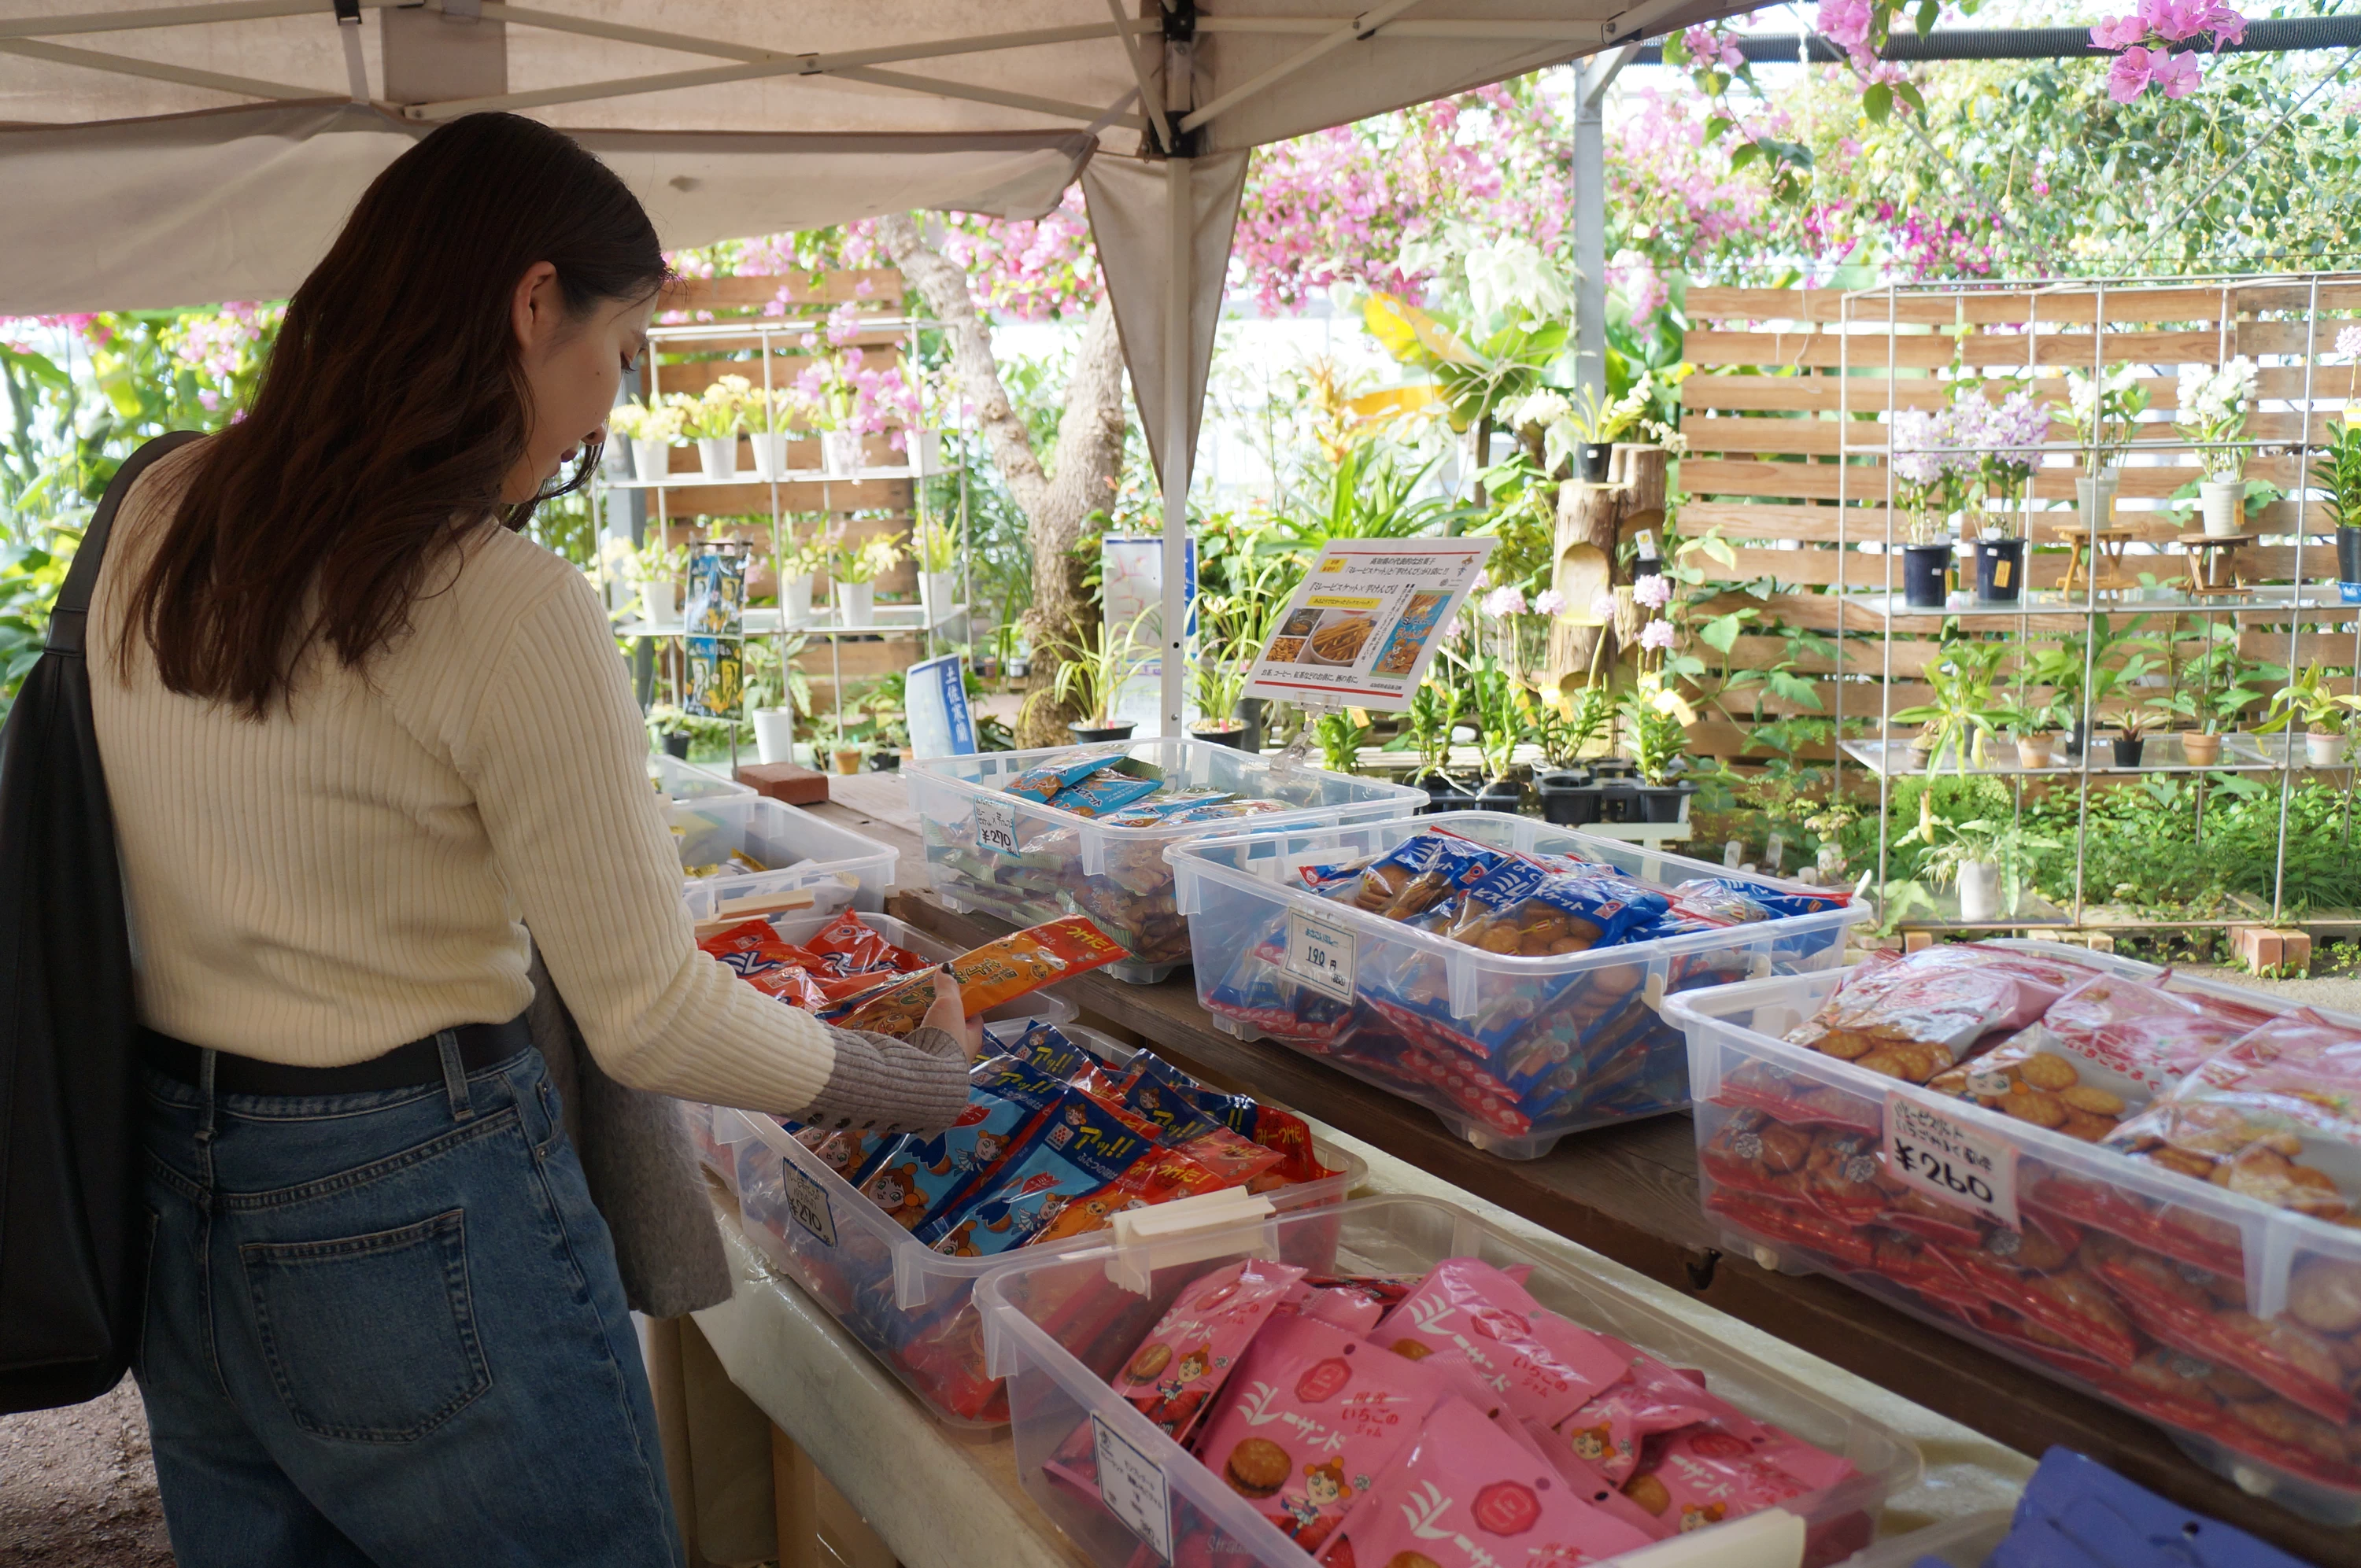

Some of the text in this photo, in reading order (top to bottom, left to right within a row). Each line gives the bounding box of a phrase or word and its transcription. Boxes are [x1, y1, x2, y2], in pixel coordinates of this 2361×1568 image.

[945, 665, 970, 743] 土佐寒蘭
[981, 828, 1011, 848] ¥270
[1051, 923, 1118, 952] ーつけた!
[1306, 946, 1337, 971] 190 円
[1894, 1137, 1993, 1204] ¥260
[788, 1197, 822, 1232] ¥270
[1236, 1381, 1347, 1452] ミレーサンド
[1341, 1407, 1399, 1426] いちごの
[1670, 1455, 1736, 1496] ーサンド
